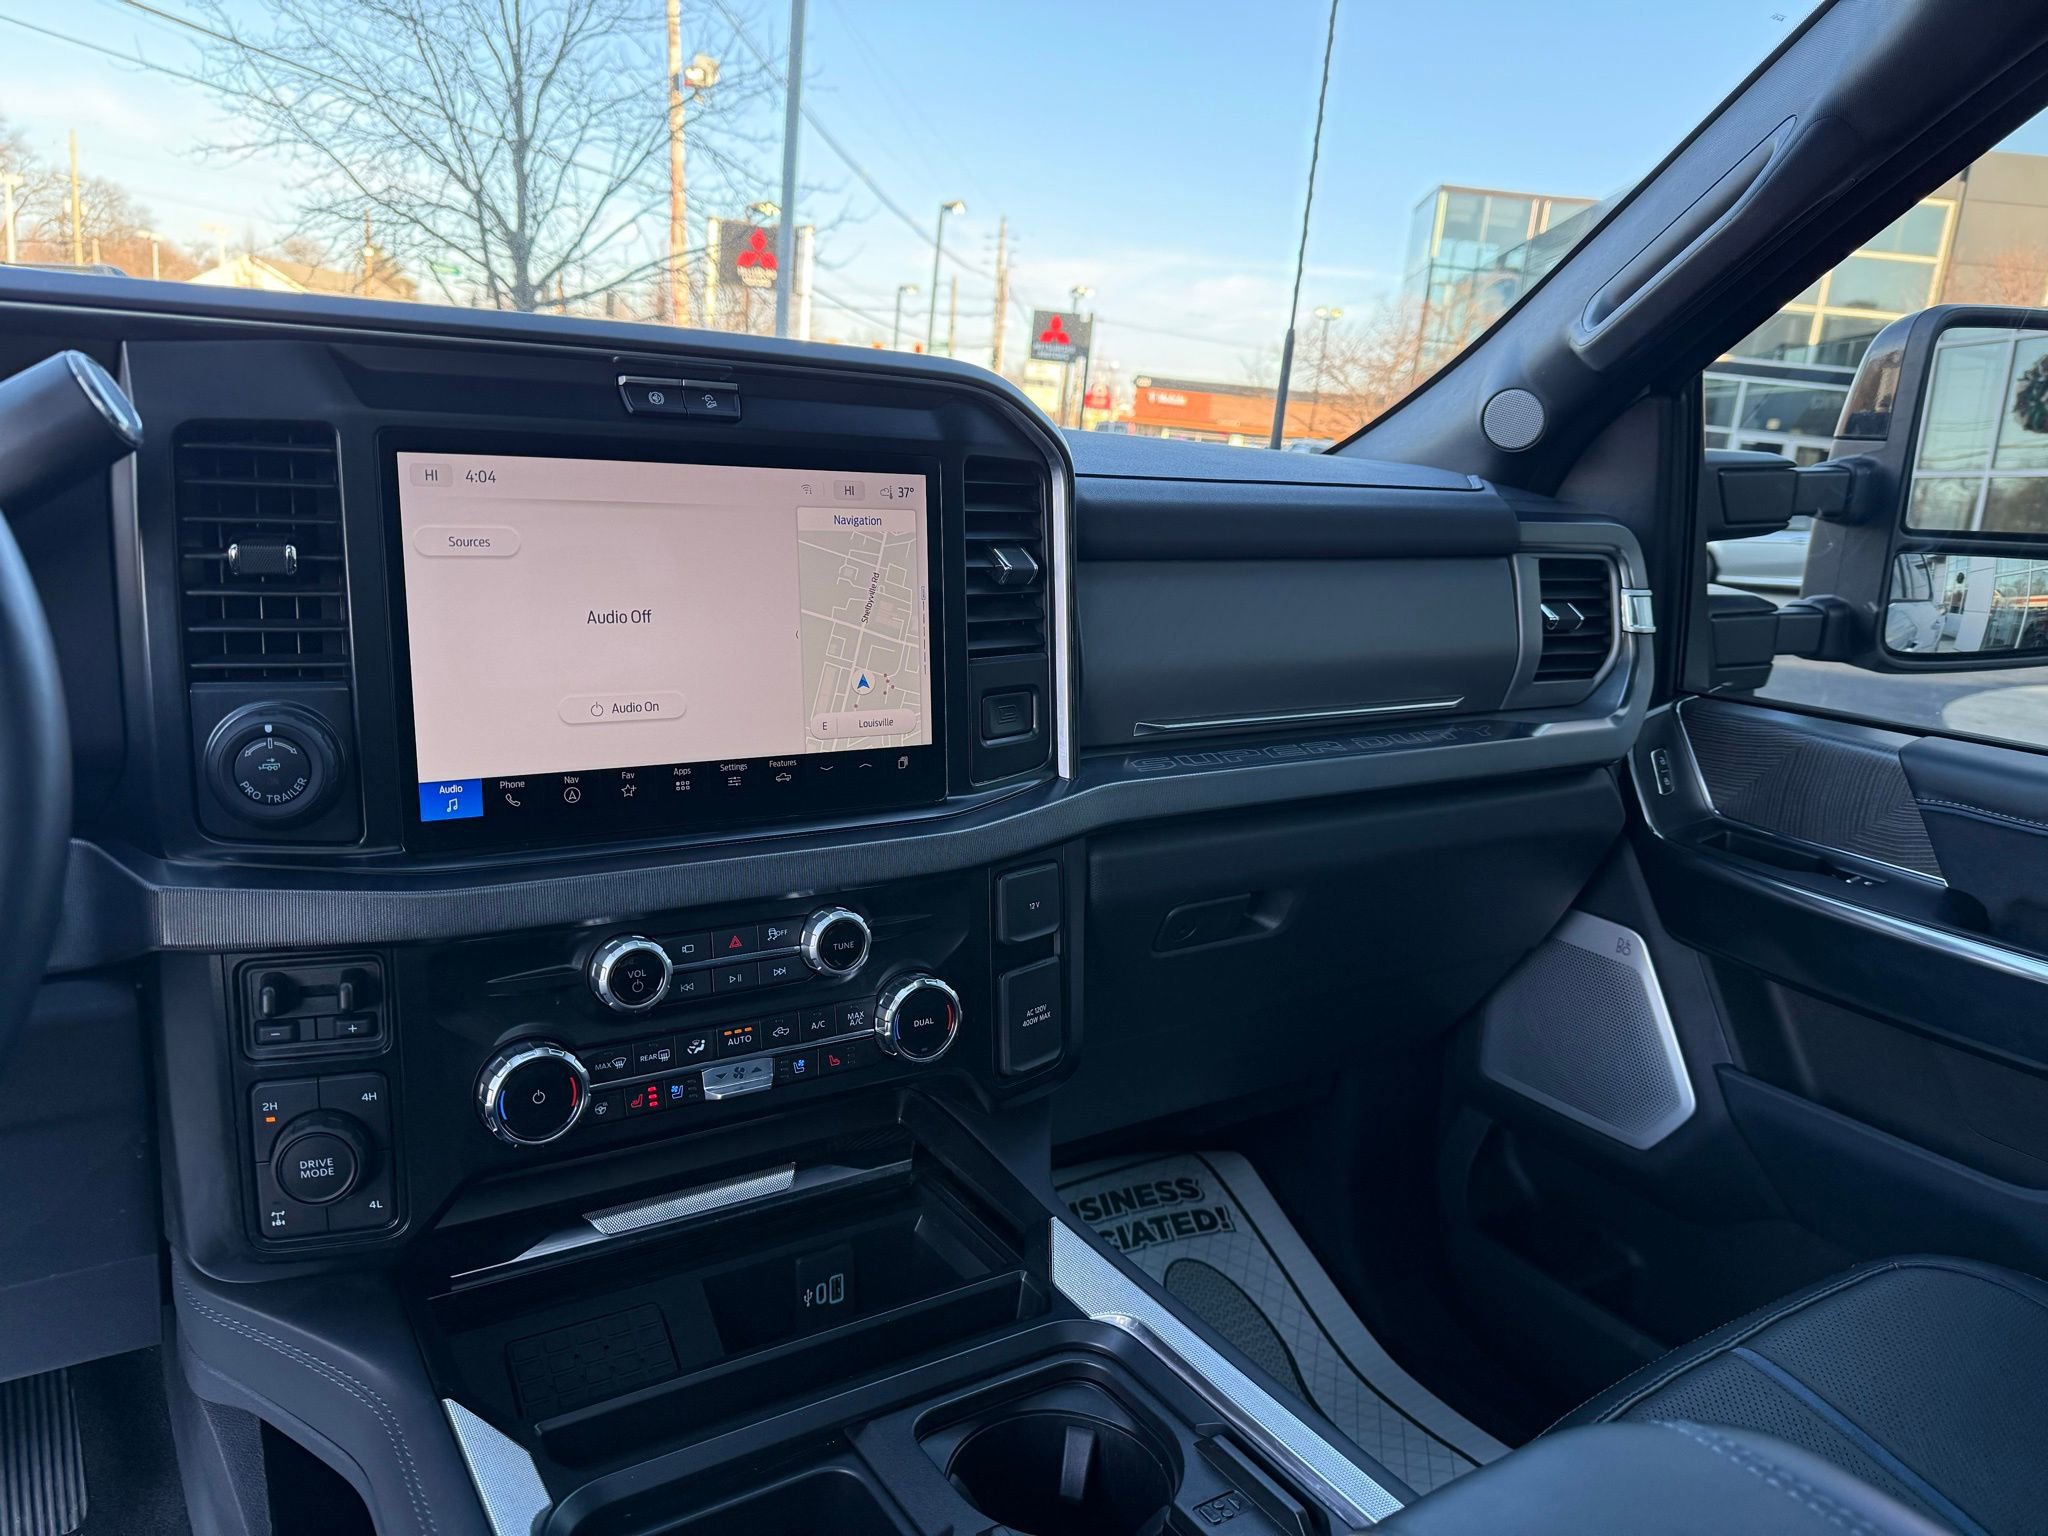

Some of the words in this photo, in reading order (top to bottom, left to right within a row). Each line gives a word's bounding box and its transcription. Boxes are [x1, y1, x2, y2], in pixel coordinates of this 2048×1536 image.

[424, 469, 439, 482] HI
[465, 470, 497, 484] 4:04
[844, 485, 855, 497] HI
[897, 486, 915, 498] 37°
[833, 514, 882, 528] Navigation
[448, 536, 491, 548] Sources
[861, 584, 877, 624] Shelbyville
[873, 571, 881, 584] Rd
[586, 610, 628, 624] Audio
[630, 609, 652, 624] Off
[611, 702, 642, 714] Audio
[644, 701, 660, 712] On
[822, 721, 828, 731] E
[858, 716, 894, 729] Louisville
[1131, 739, 1344, 773] SUPER
[1352, 723, 1493, 749] DUTY
[719, 762, 749, 774] Settings
[768, 758, 798, 769] Features
[621, 771, 635, 780] Fav
[673, 767, 692, 778] Apps
[499, 780, 526, 790] Phone
[564, 775, 580, 785] Nav
[240, 780, 261, 800] PRO
[266, 777, 307, 804] TRAILER
[438, 784, 464, 795] Audio
[776, 928, 788, 938] OFF
[832, 940, 855, 951] TUNE
[627, 969, 647, 979] VOL
[847, 1010, 865, 1020] MAX
[1039, 1010, 1051, 1021] MAX
[811, 1020, 826, 1030] A/C
[849, 1017, 864, 1027] A/C
[912, 1017, 935, 1028] DUAL
[727, 1034, 752, 1046] AUTO
[639, 1053, 658, 1062] REAR
[594, 1062, 612, 1071] MAX
[361, 1092, 378, 1102] 4H
[262, 1102, 278, 1112] 2H
[299, 1157, 334, 1170] DRIVE
[300, 1167, 335, 1179] MODE
[369, 1200, 383, 1209] 4L
[1069, 1177, 1202, 1222] SINESS
